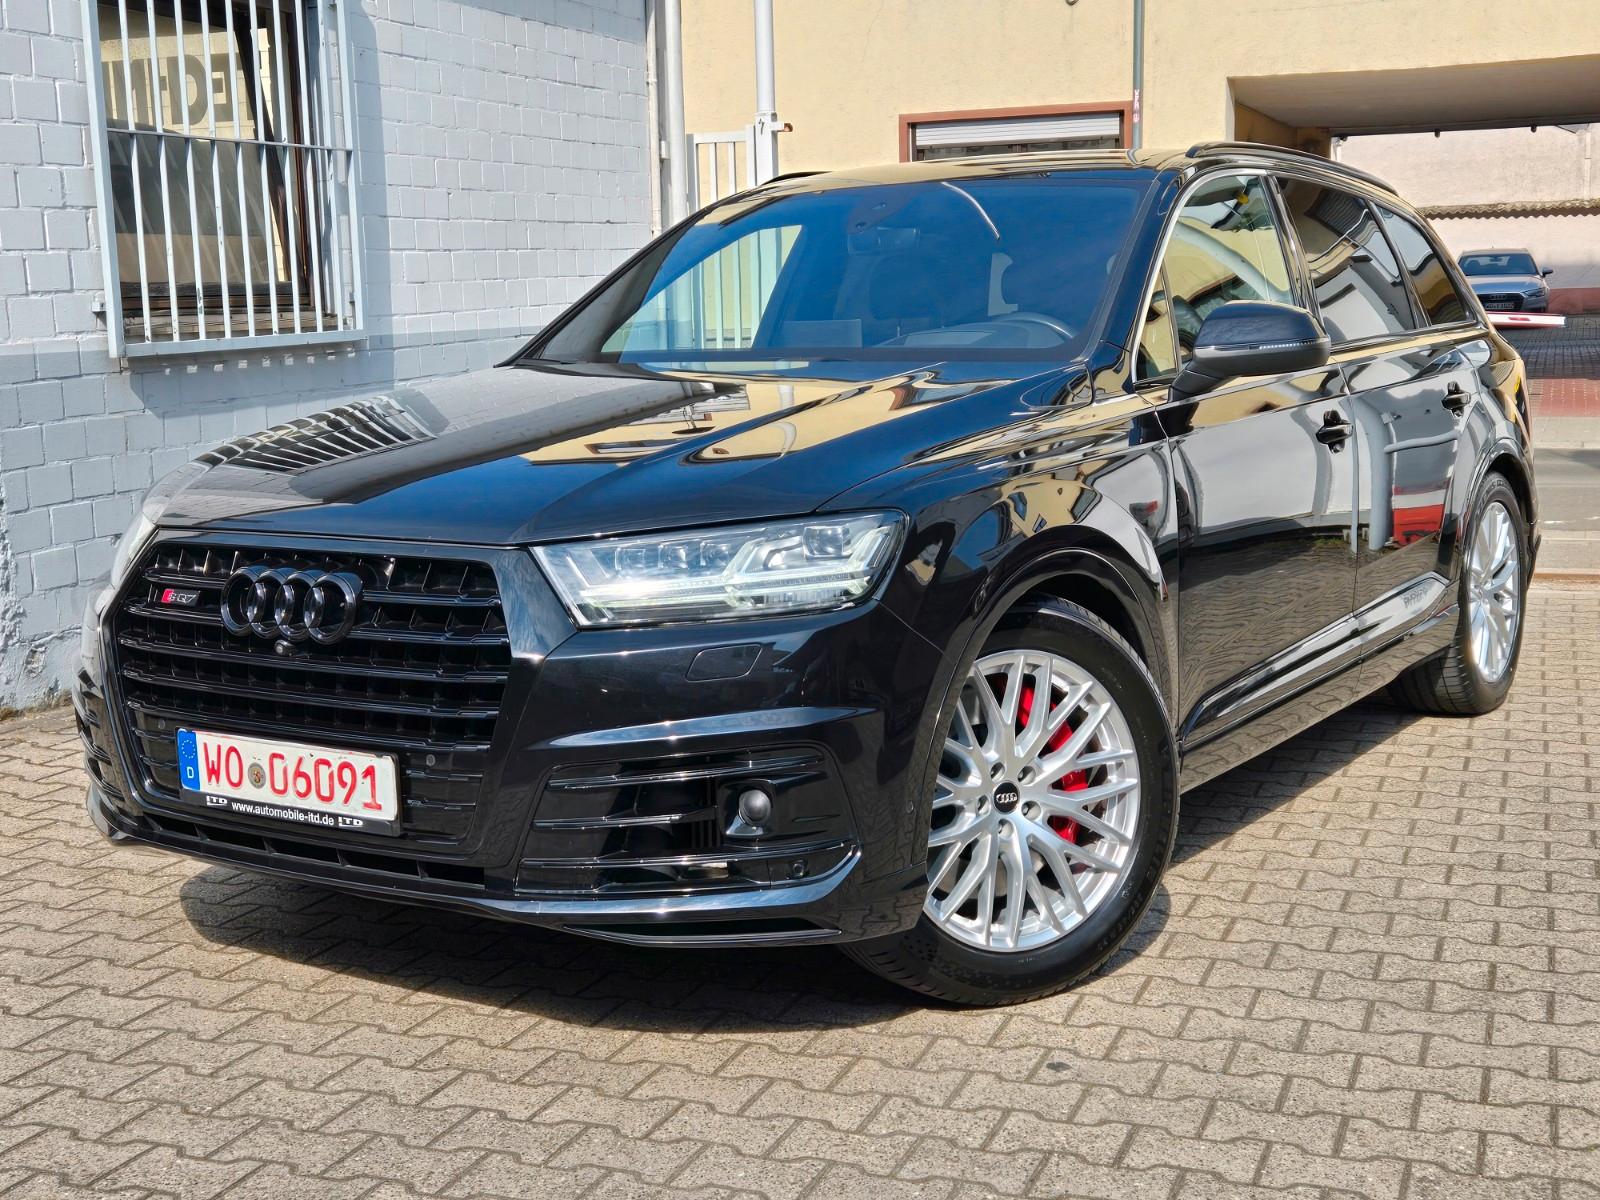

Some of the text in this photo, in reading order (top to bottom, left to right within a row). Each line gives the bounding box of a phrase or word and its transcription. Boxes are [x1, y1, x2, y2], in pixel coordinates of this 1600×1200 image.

[187, 766, 194, 779] D
[203, 741, 382, 811] WO 06091
[231, 801, 335, 826] www.automobile-itd.de
